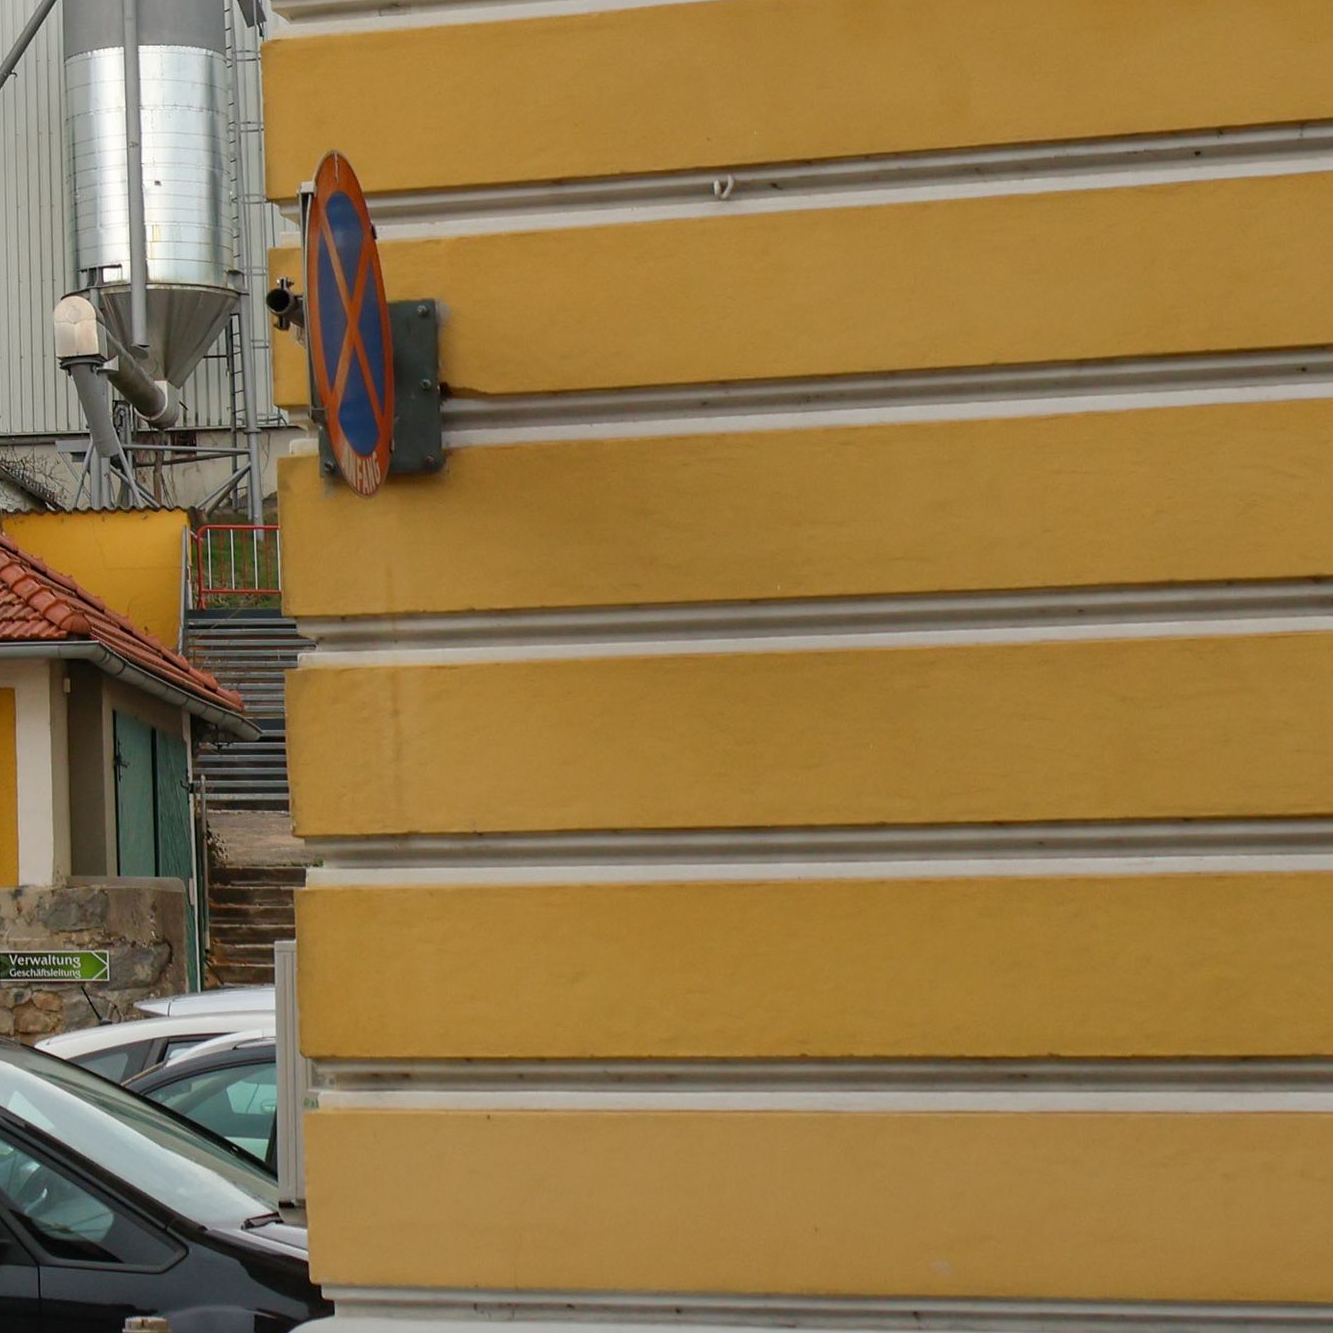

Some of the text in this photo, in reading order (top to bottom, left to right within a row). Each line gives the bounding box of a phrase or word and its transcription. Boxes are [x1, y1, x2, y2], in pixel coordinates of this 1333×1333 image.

[341, 442, 381, 494] ANFANG
[9, 954, 81, 968] Verwaltung
[9, 968, 81, 979] Geschäftsleitung
